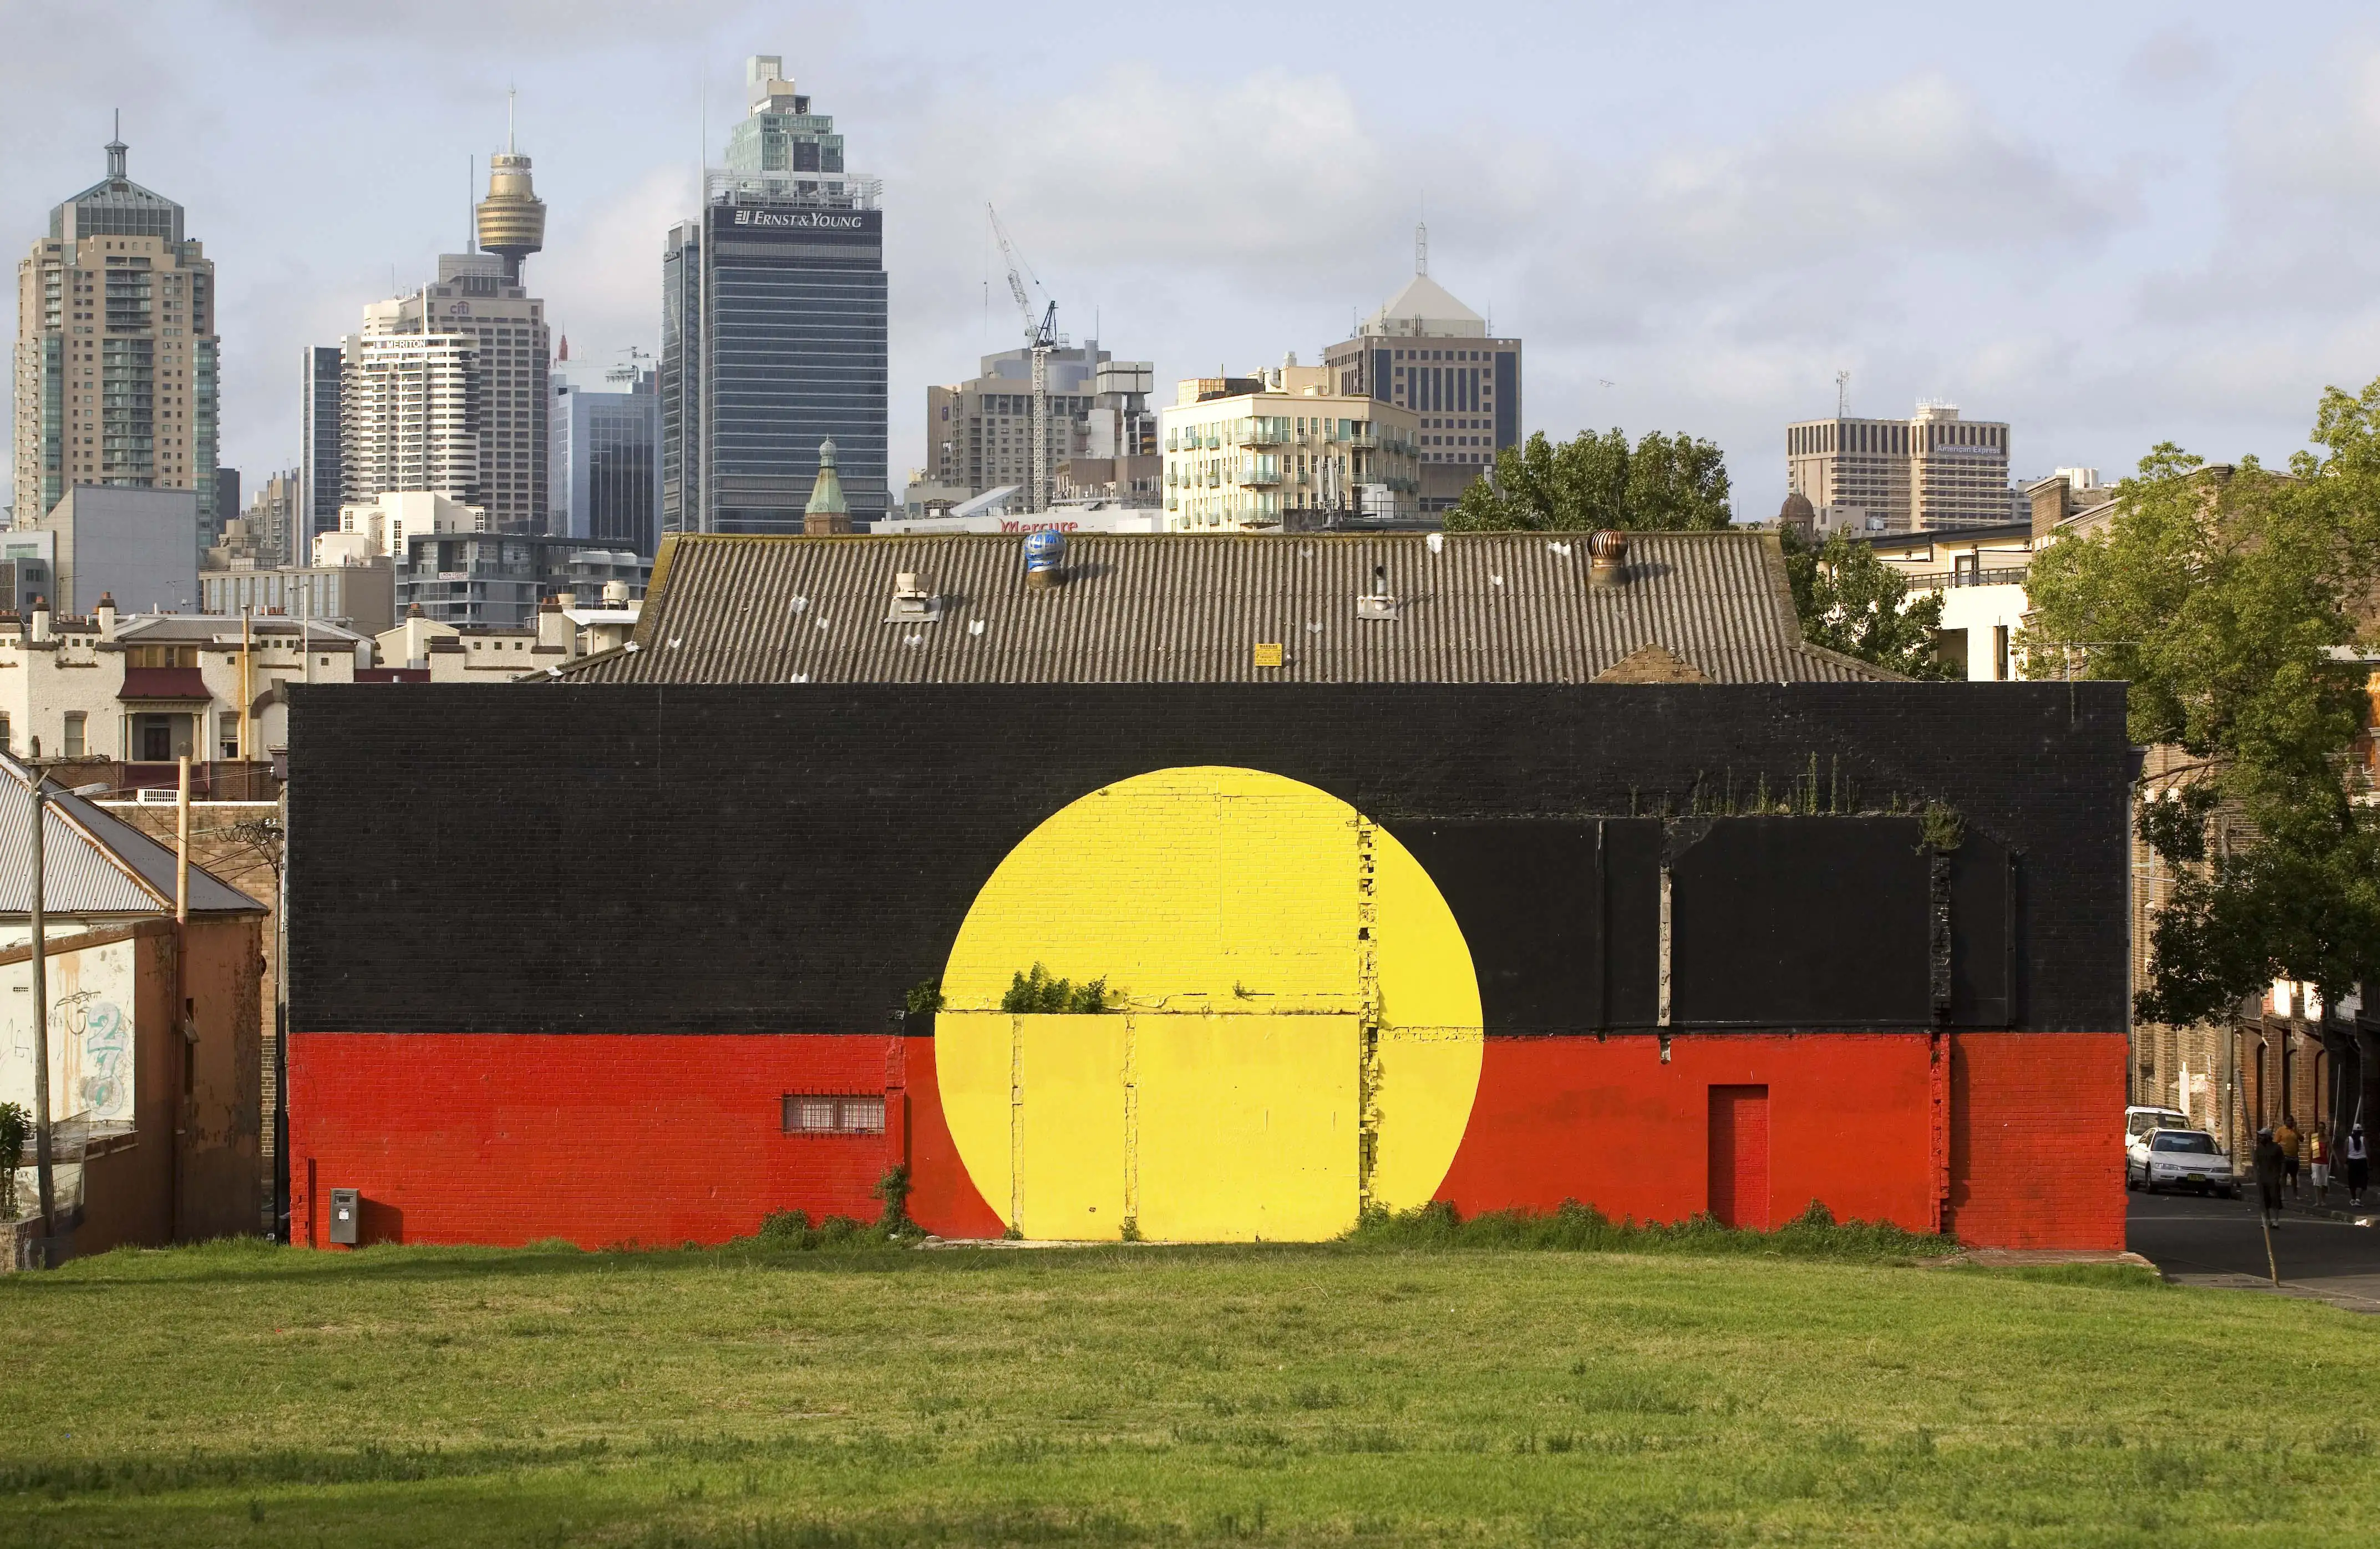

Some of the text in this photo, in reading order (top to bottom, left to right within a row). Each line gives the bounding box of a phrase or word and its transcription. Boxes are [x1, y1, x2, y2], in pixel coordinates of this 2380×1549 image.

[799, 215, 809, 227] &
[450, 301, 470, 315] citi
[386, 340, 426, 348] MERITON
[1936, 444, 2001, 454] American Express
[997, 518, 1078, 533] Mercure
